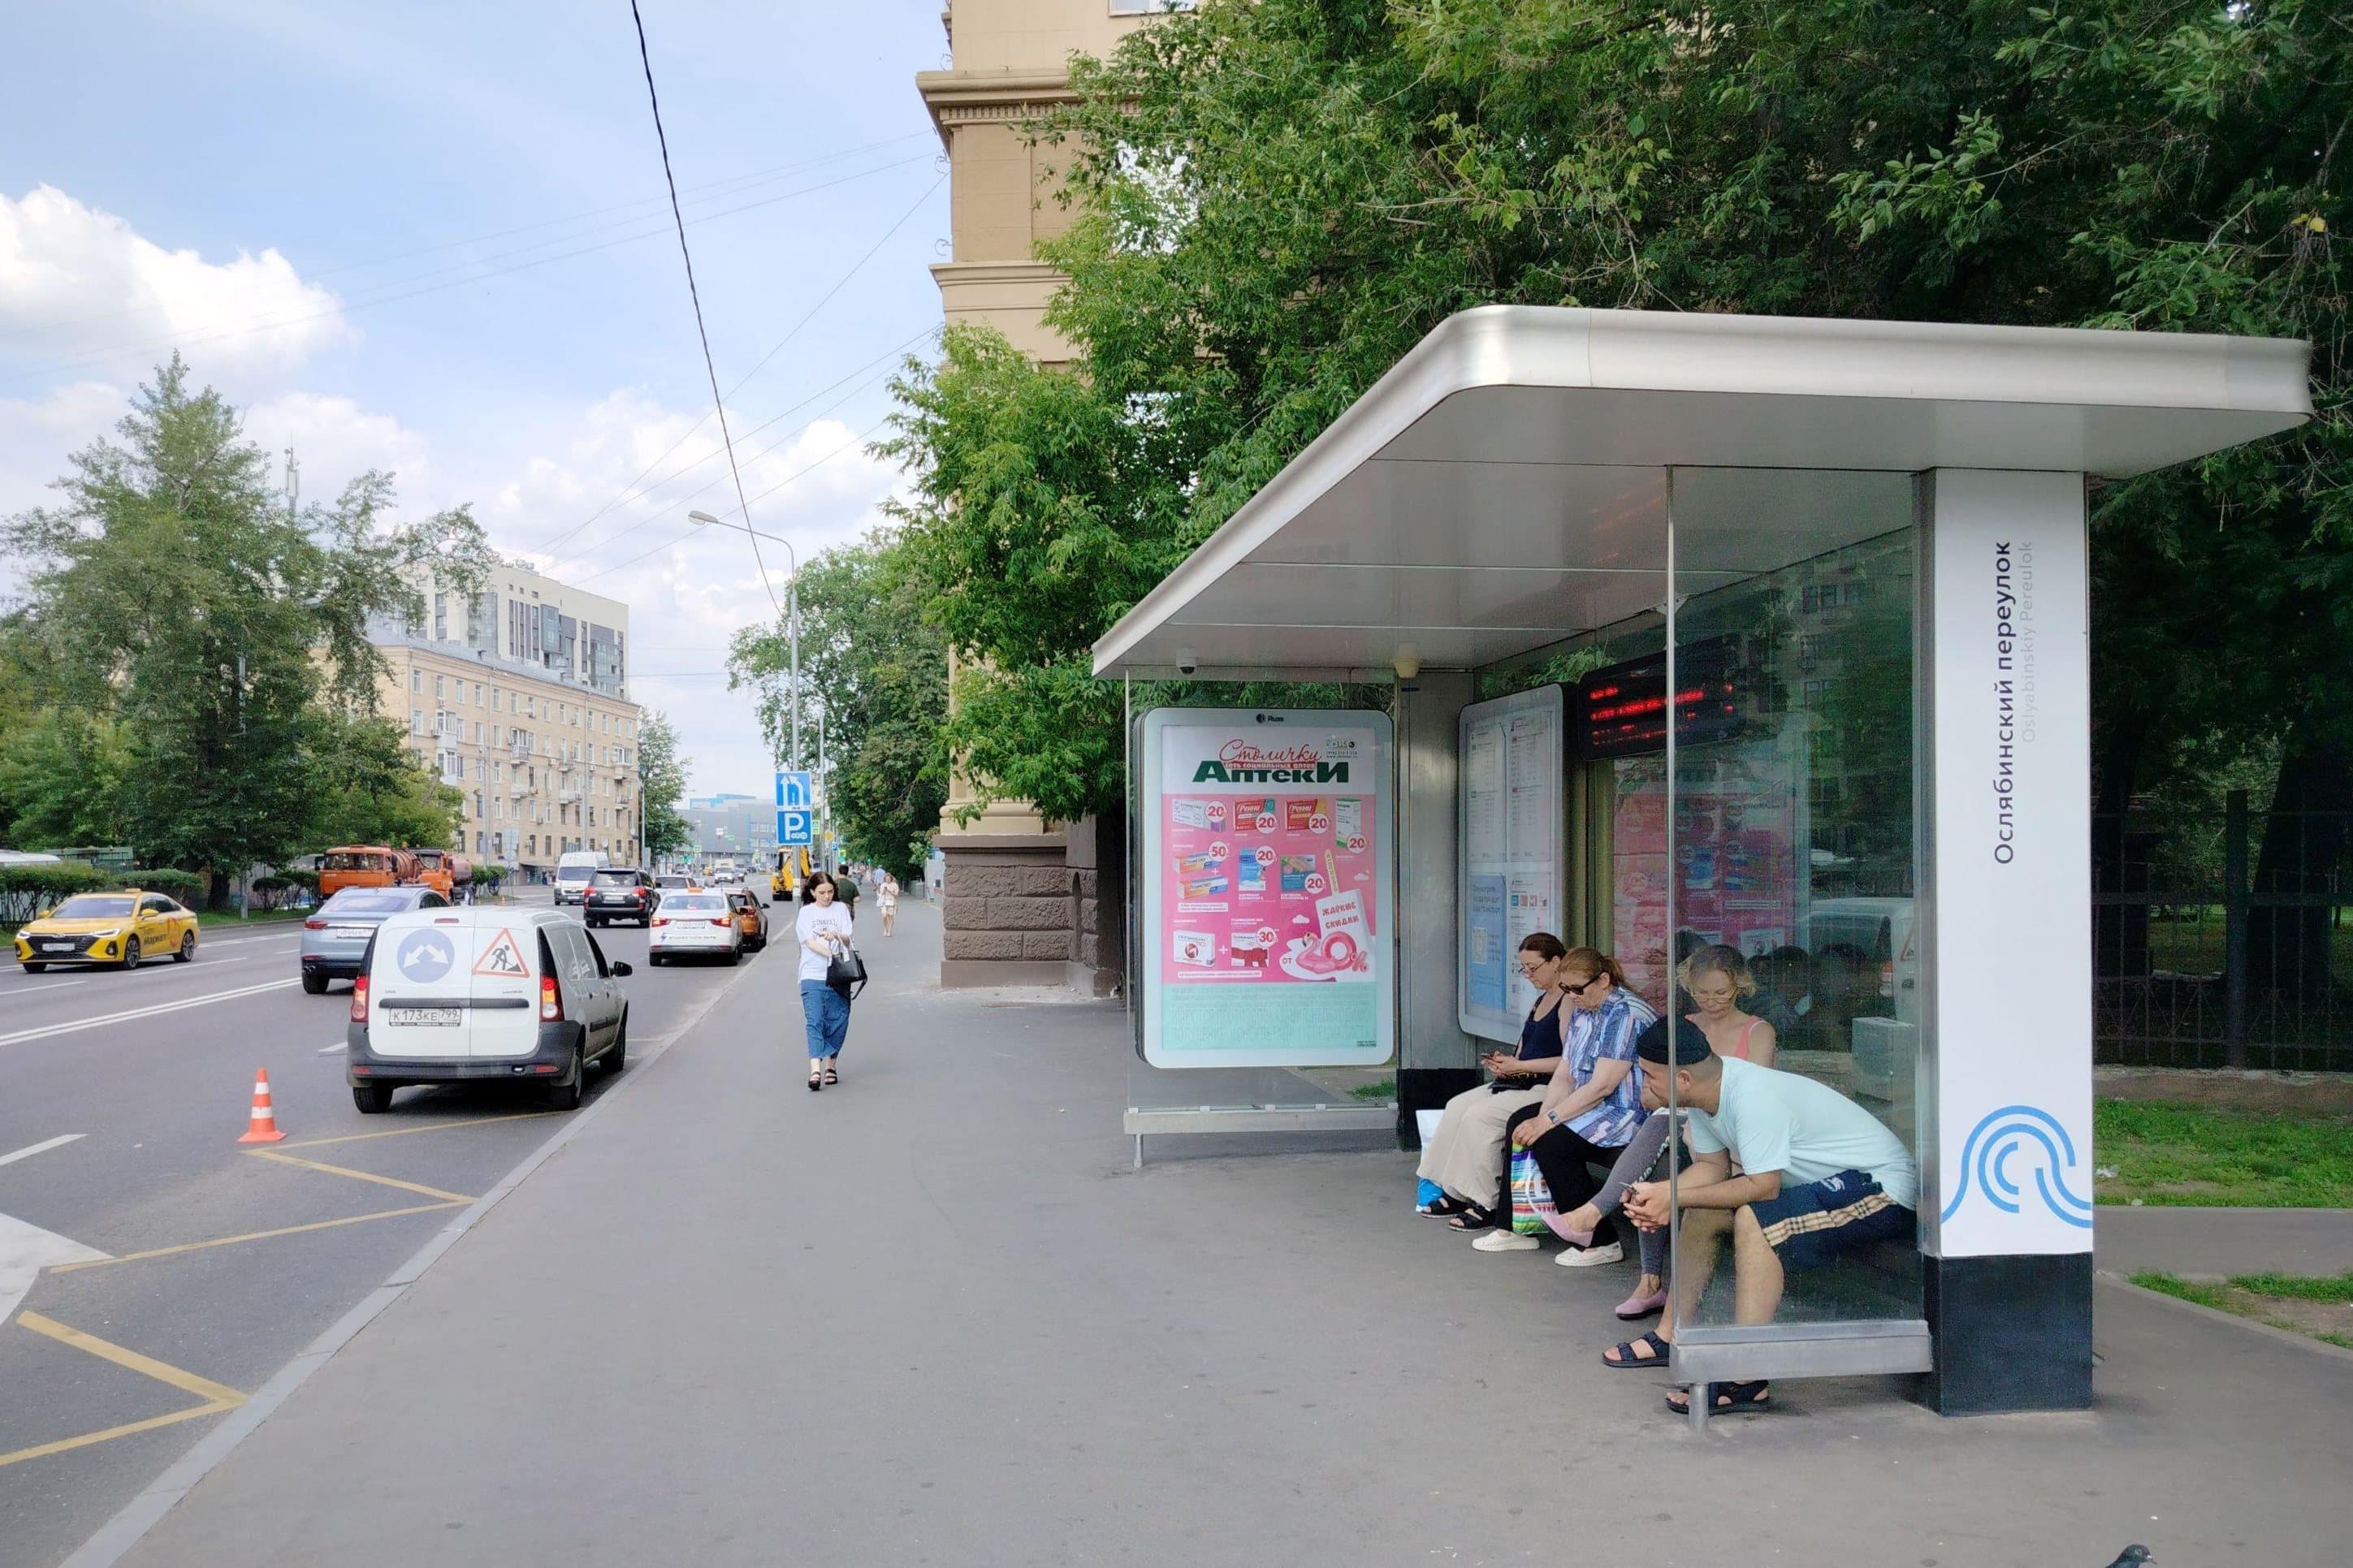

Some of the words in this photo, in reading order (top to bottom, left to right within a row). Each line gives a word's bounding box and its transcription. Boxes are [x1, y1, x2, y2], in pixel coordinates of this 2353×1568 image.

[1996, 541, 2016, 670] переулок
[2020, 541, 2034, 621] Pereulok
[1219, 739, 1322, 762] Столички
[1993, 680, 2013, 864] Ослябинский
[784, 813, 804, 840] P
